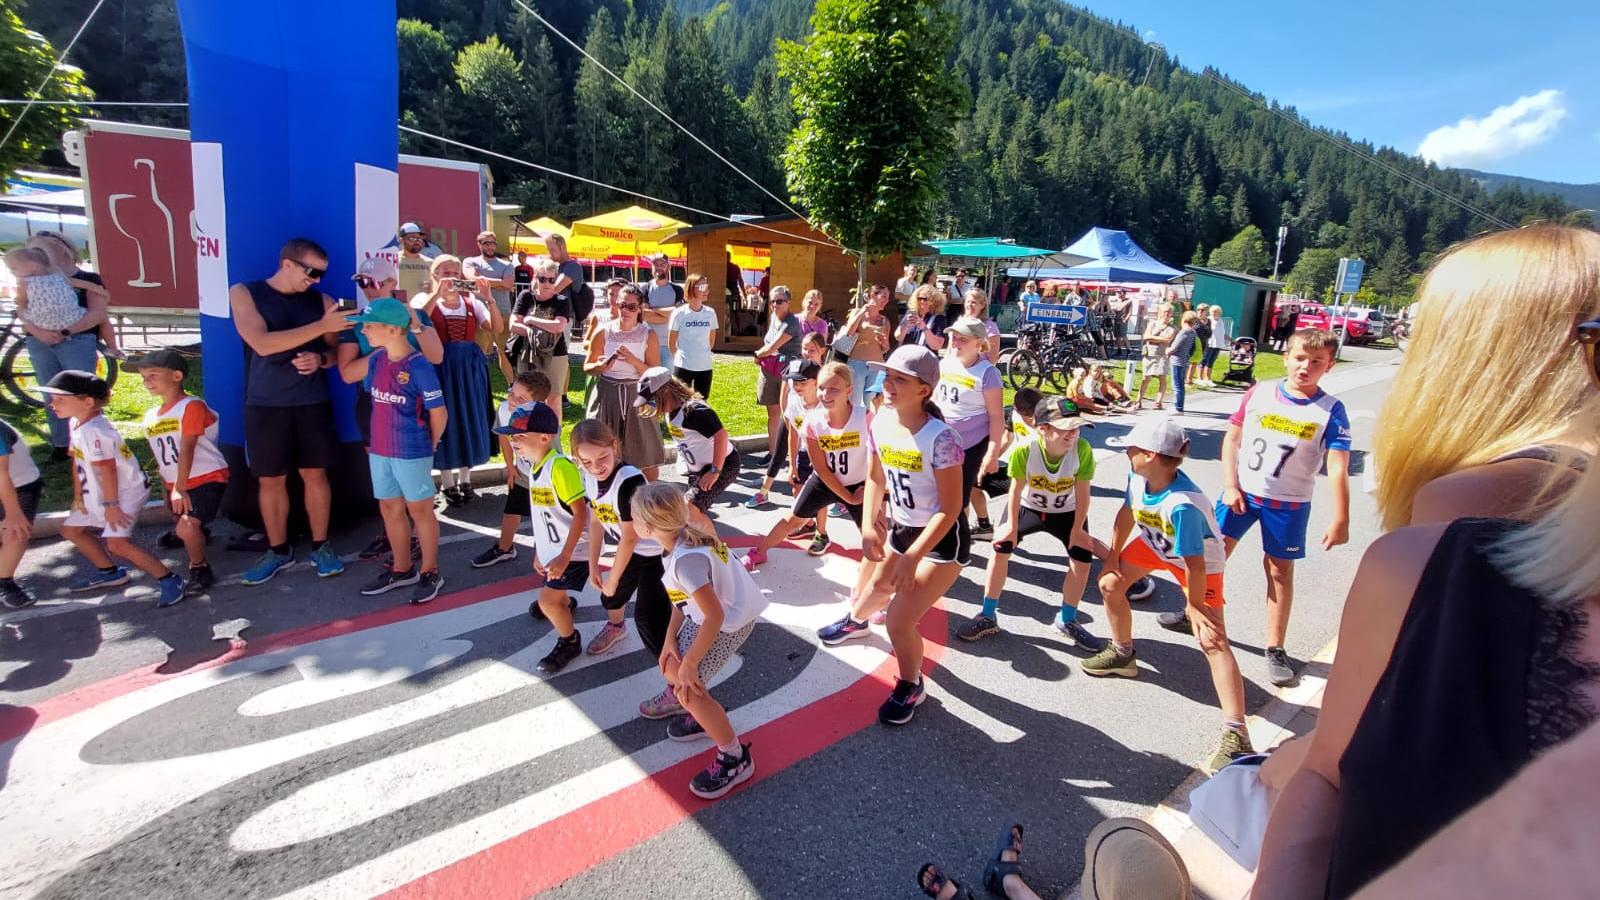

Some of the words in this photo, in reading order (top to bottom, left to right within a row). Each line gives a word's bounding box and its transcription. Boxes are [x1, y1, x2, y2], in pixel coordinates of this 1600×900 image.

[600, 227, 633, 239] Sinalco
[753, 247, 770, 257] Sina
[685, 320, 710, 328] adidas
[1036, 309, 1073, 319] EINBAHN
[940, 384, 959, 404] 33
[157, 436, 179, 465] 23
[1247, 437, 1297, 478] 37
[829, 450, 849, 476] 39
[887, 469, 915, 510] 35
